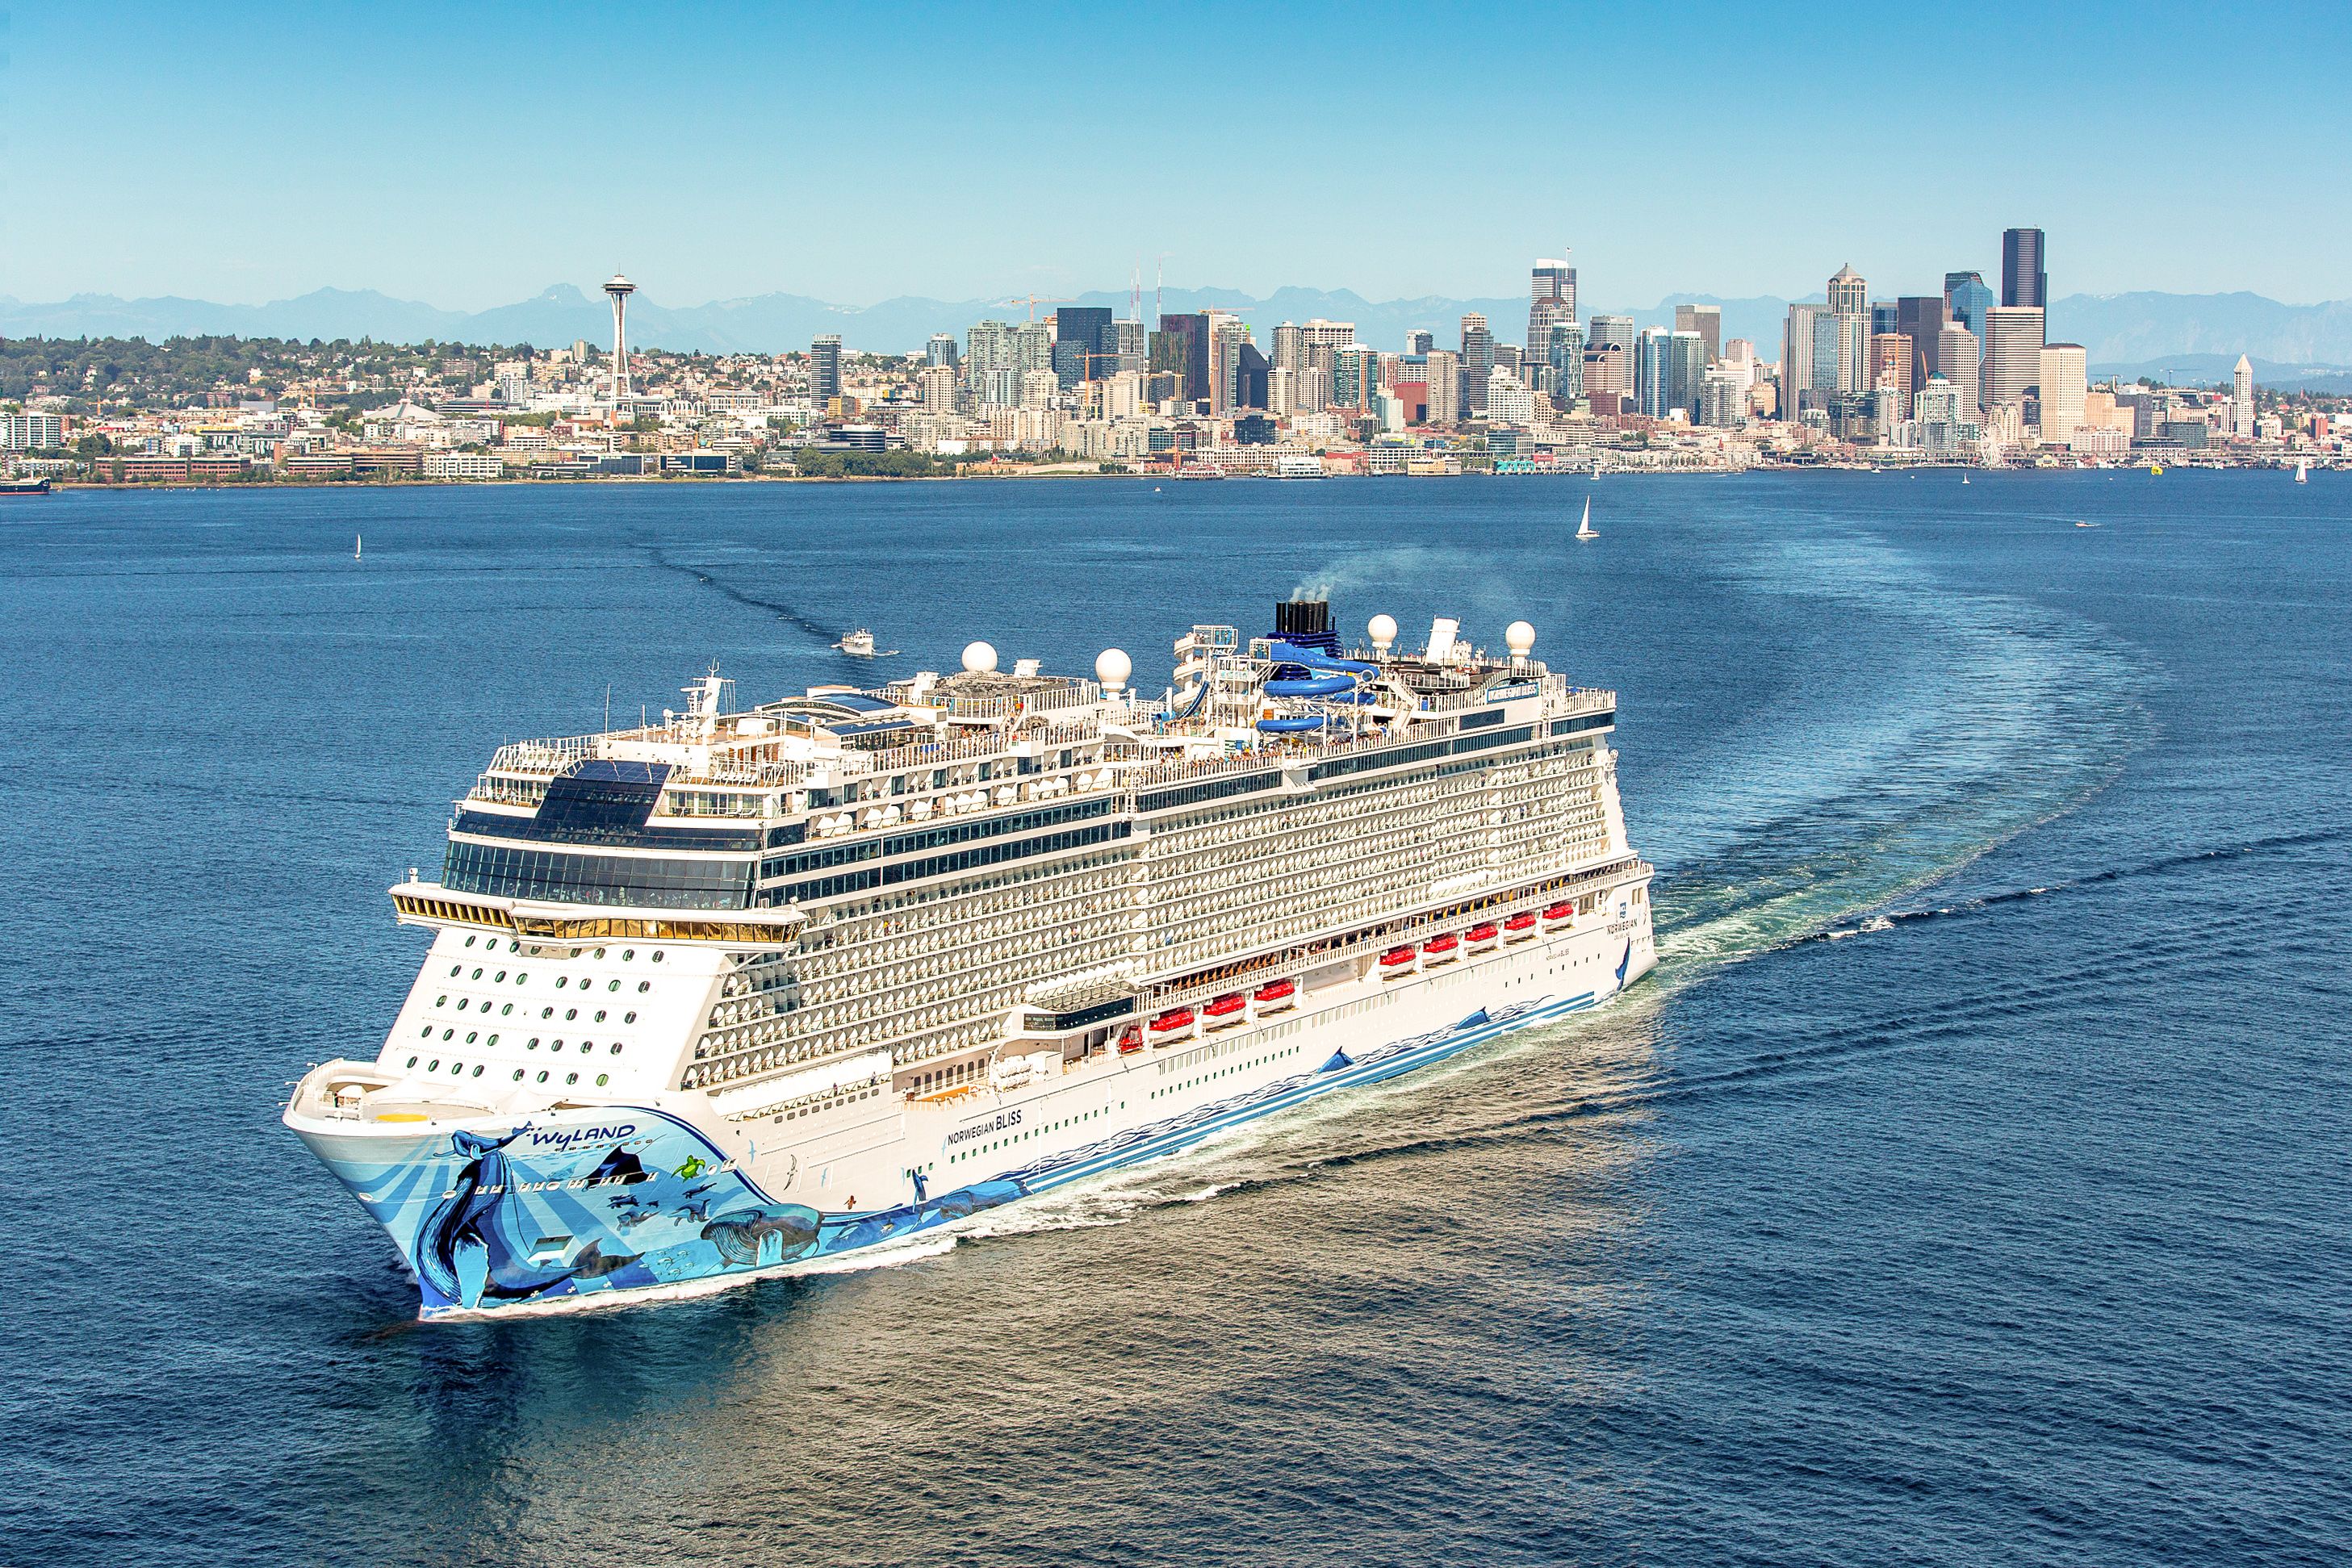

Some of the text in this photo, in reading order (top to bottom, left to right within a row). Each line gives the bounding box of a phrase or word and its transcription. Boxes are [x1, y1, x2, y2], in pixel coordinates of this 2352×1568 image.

[1607, 918, 1638, 935] NORWEGIAN
[948, 1110, 1022, 1146] NORWEGIAN BLISS
